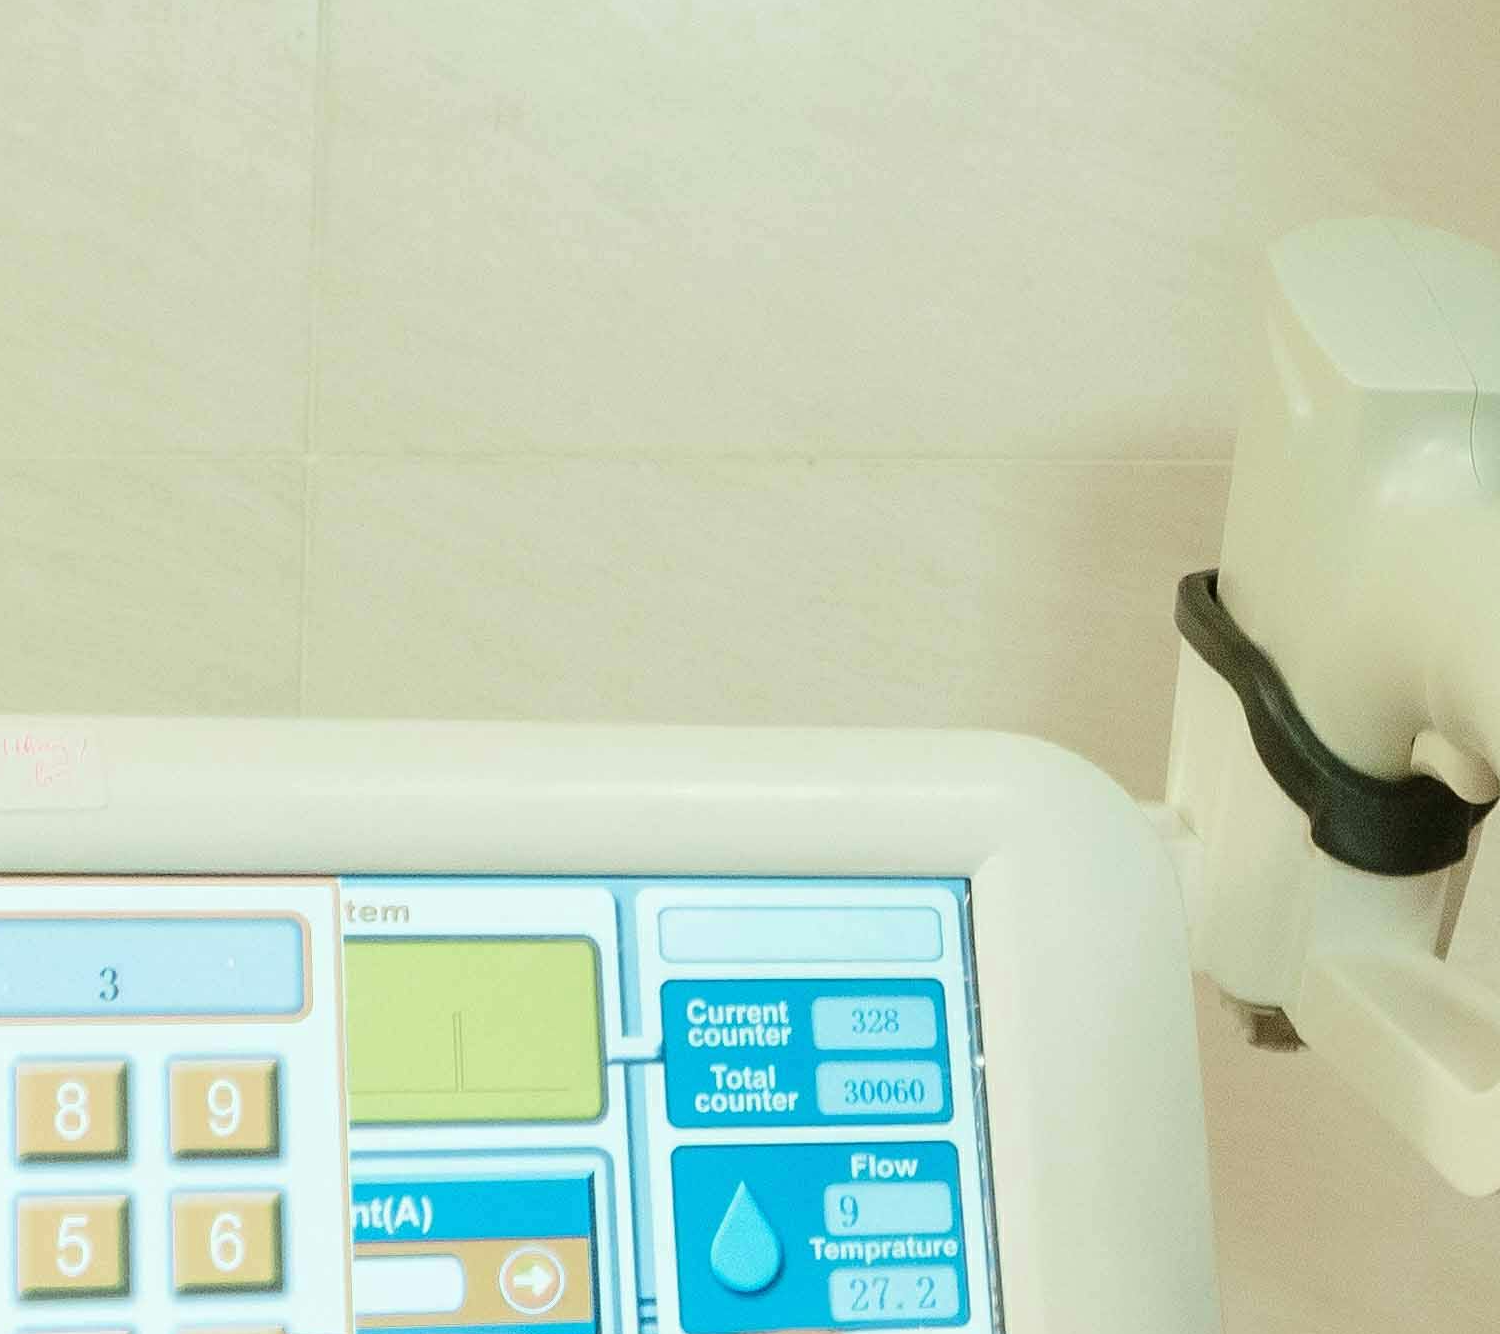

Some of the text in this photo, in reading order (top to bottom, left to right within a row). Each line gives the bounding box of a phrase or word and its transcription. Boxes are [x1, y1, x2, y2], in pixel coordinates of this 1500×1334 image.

[345, 899, 411, 923] tem
[99, 965, 120, 1002] 3
[686, 1000, 790, 1025] Current
[851, 1009, 900, 1035] 328
[687, 1024, 792, 1048] counter
[709, 1063, 776, 1090] Total
[694, 1088, 799, 1113] counter
[843, 1078, 925, 1105] 30060
[54, 1082, 91, 1140] 8
[206, 1079, 242, 1137] 9
[850, 1153, 918, 1179] Flow
[839, 1194, 859, 1227] 9
[56, 1215, 91, 1276] 5
[209, 1212, 246, 1269] 6
[809, 1236, 958, 1264] Temprature
[849, 1276, 937, 1311] 27.2
